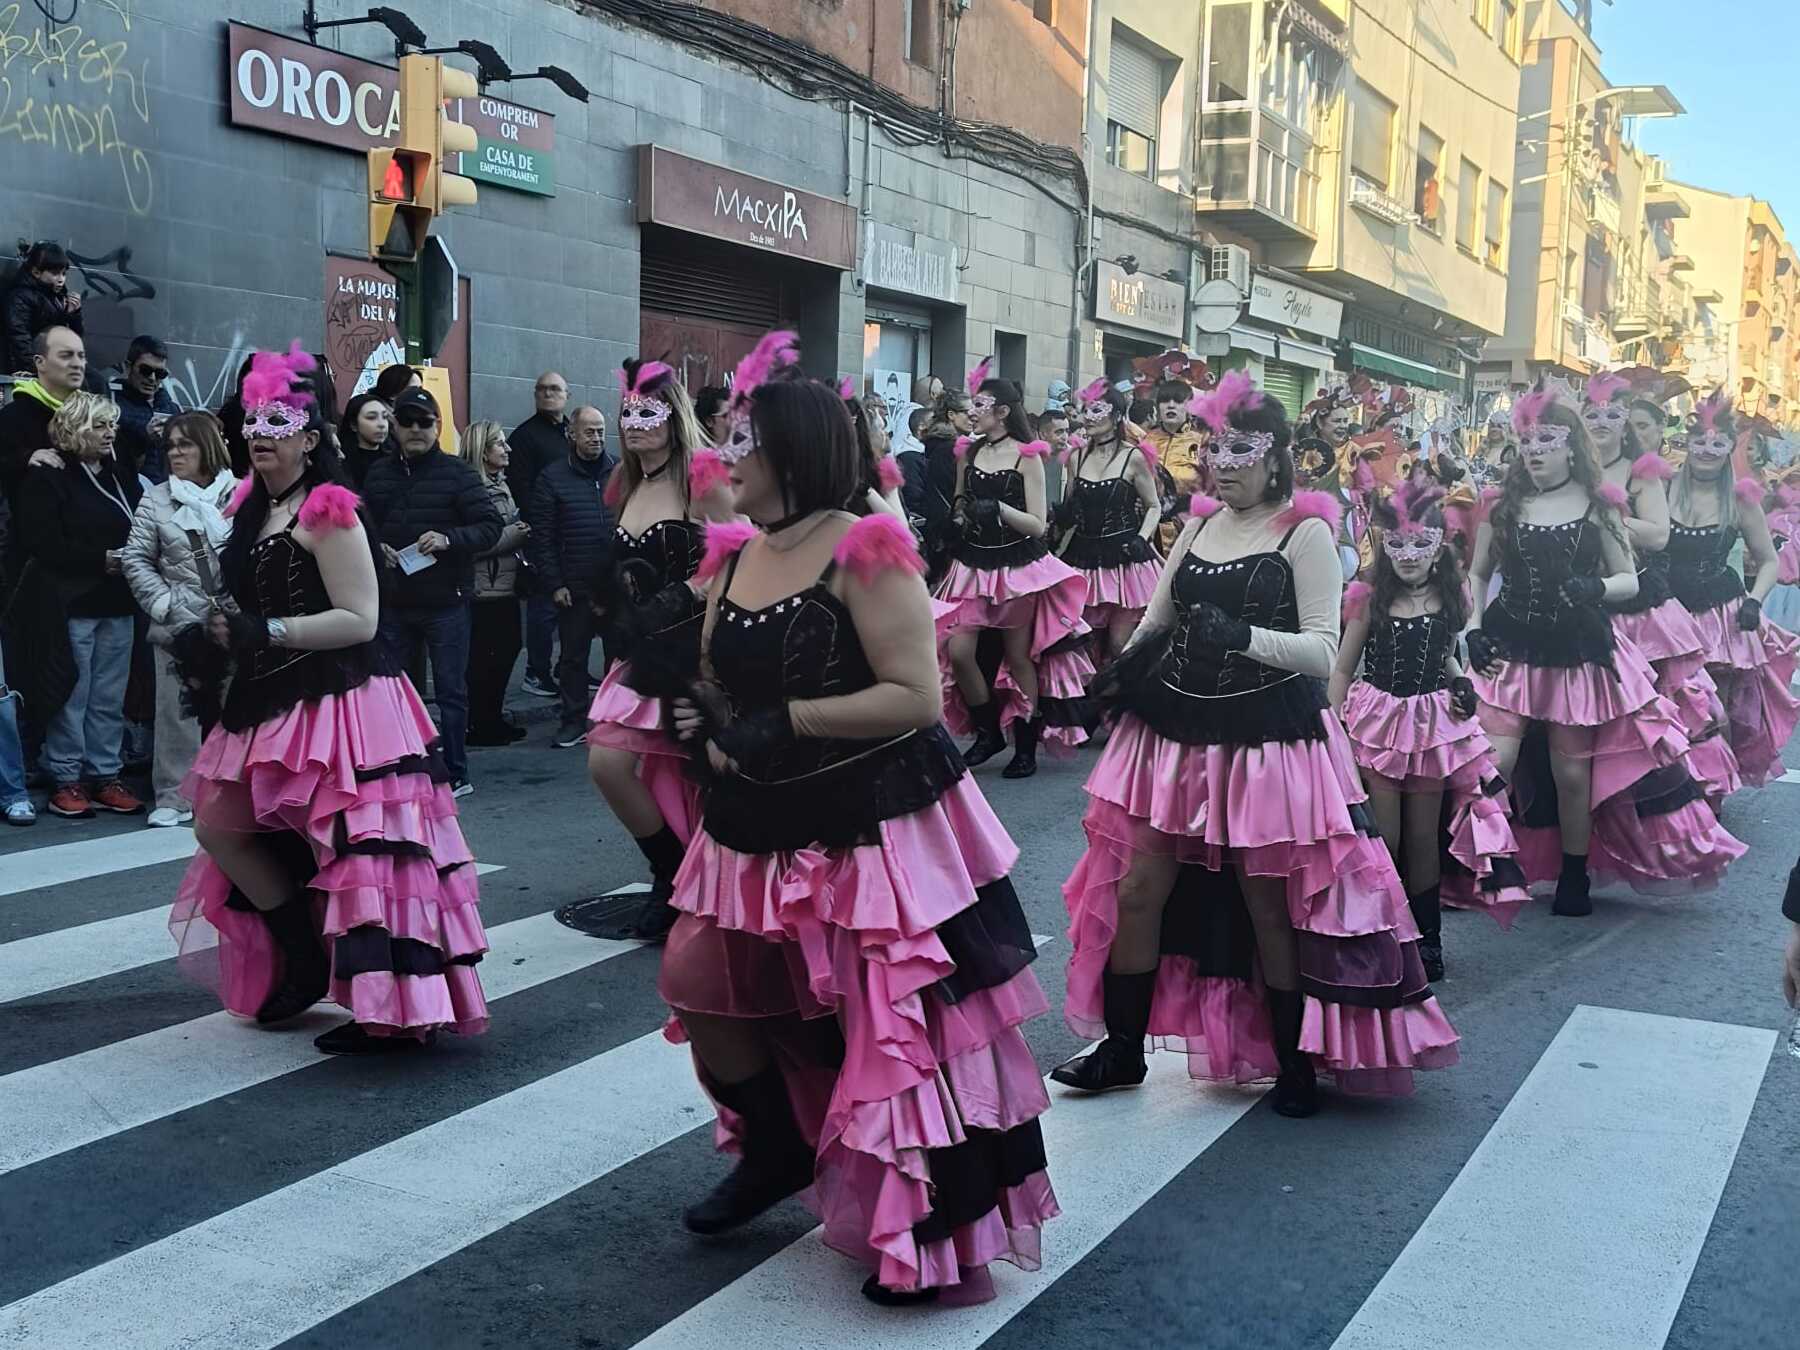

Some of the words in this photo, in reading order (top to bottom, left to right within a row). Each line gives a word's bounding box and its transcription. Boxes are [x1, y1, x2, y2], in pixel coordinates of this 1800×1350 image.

[480, 99, 539, 128] COMPREM
[501, 122, 519, 141] OR
[486, 146, 516, 168] CASA
[518, 154, 534, 171] DE
[480, 161, 539, 184] EMPENYORAMENT
[338, 276, 354, 293] LA
[1110, 279, 1138, 305] BIEN
[361, 303, 383, 321] DEL
